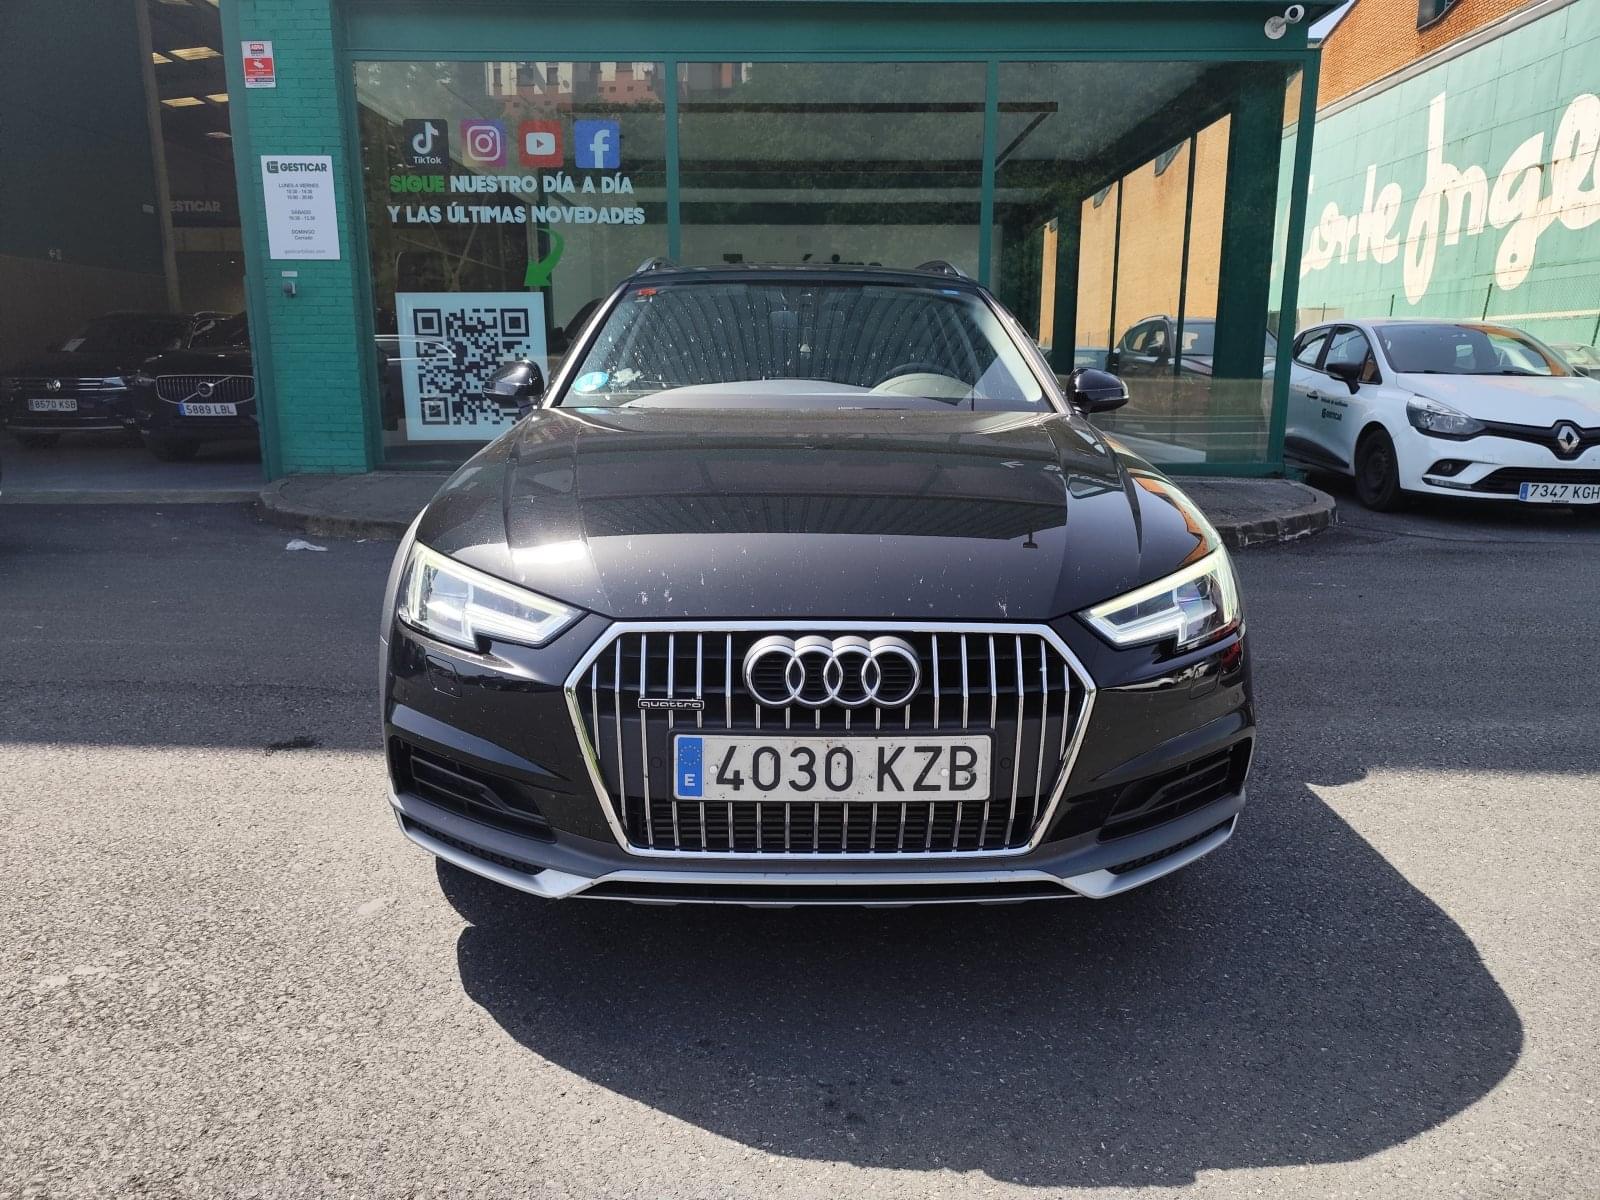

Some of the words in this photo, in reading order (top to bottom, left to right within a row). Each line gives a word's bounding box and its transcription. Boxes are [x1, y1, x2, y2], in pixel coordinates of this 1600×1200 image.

[280, 163, 327, 172] GESTICAR
[412, 156, 442, 165] TikTok
[389, 175, 445, 193] SIGUE
[450, 175, 538, 193] NUESTRO
[543, 171, 576, 194] DÍA
[582, 176, 596, 194] A
[601, 171, 634, 194] DÍA
[170, 200, 222, 212] ESTICAR
[387, 205, 401, 223] Y
[406, 205, 442, 223] LAS
[446, 201, 527, 224] ÚLTIMAS
[531, 205, 646, 225] NOVEDADES
[214, 405, 235, 415] LBL
[1530, 484, 1568, 498] 7347
[1572, 486, 1600, 500] KGH
[684, 774, 696, 787] E
[715, 745, 854, 792] 4030
[876, 745, 978, 792] KZB
